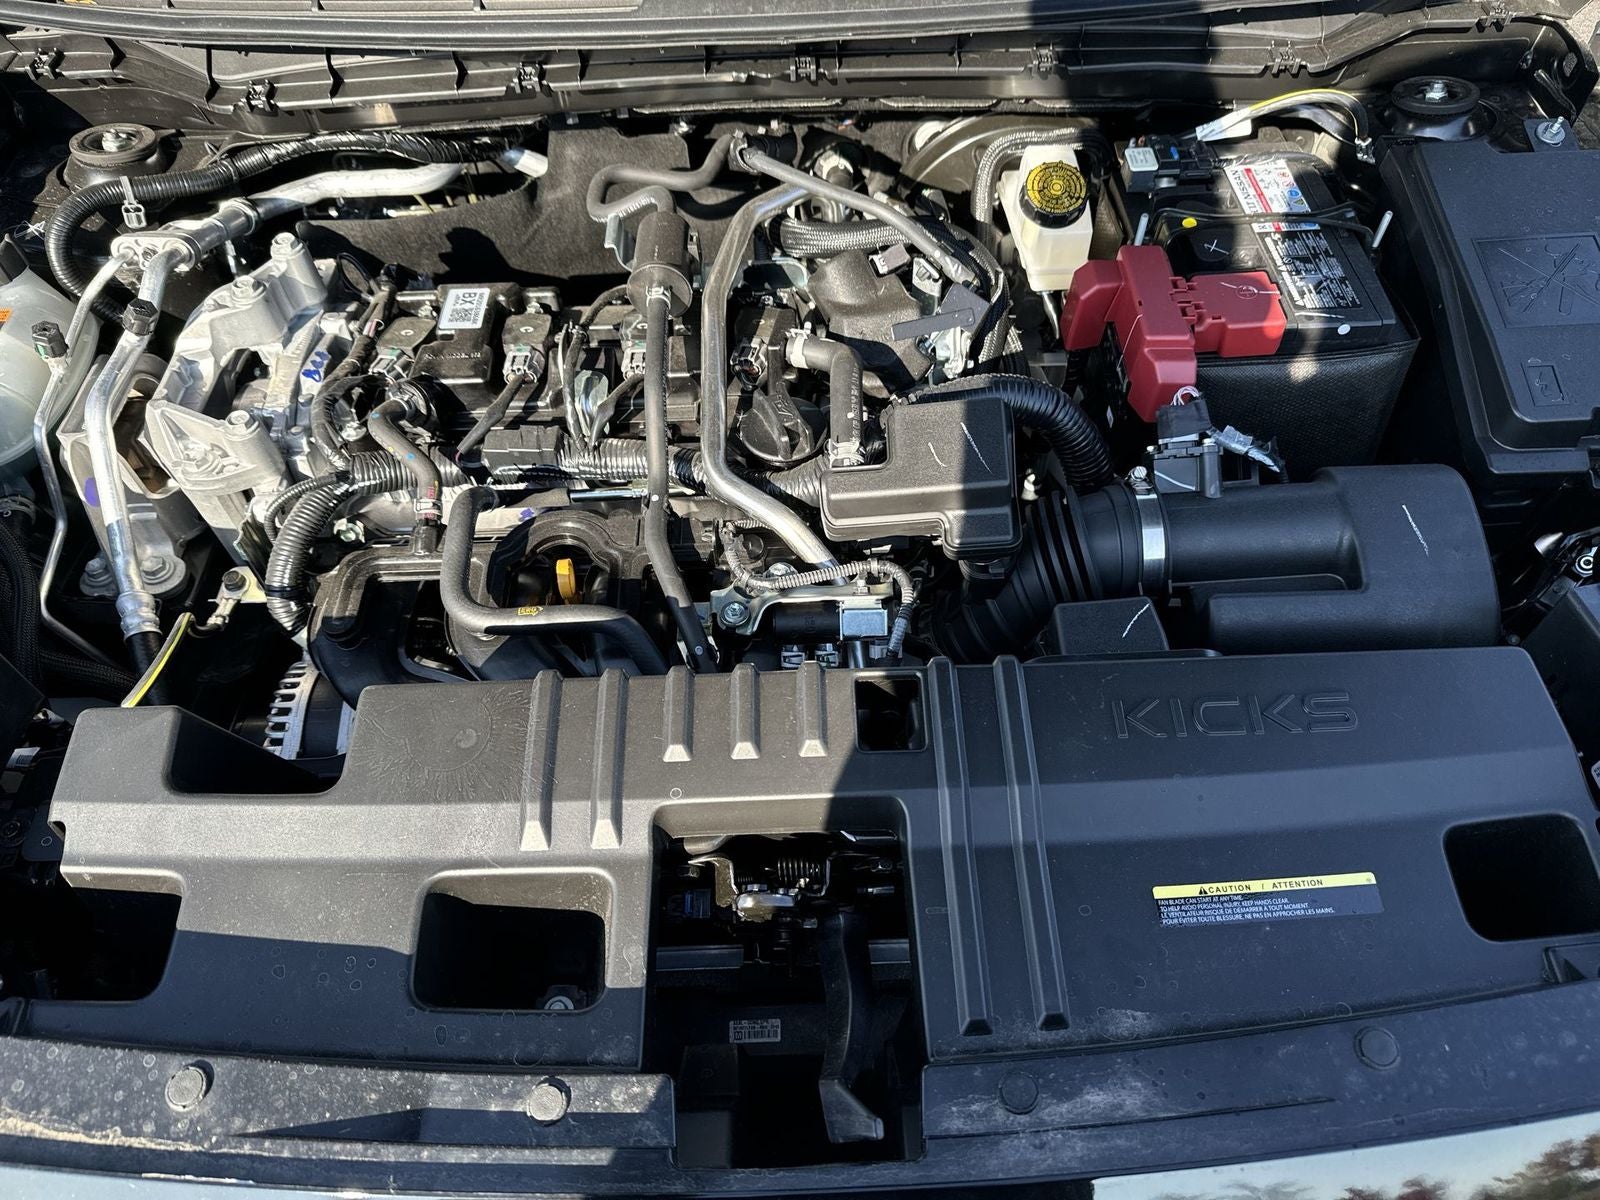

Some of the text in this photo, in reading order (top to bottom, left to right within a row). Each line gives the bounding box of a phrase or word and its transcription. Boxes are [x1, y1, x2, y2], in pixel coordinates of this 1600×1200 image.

[1231, 169, 1252, 200] NISSAN
[460, 292, 478, 306] BX
[1111, 693, 1358, 738] KICKS
[1208, 884, 1251, 894] CAUTION
[1272, 879, 1323, 889] ATTENTION
[1197, 902, 1222, 910] PERSONAL
[1272, 909, 1305, 917] APPROCHER
[1167, 910, 1204, 918] VENTILATEUR
